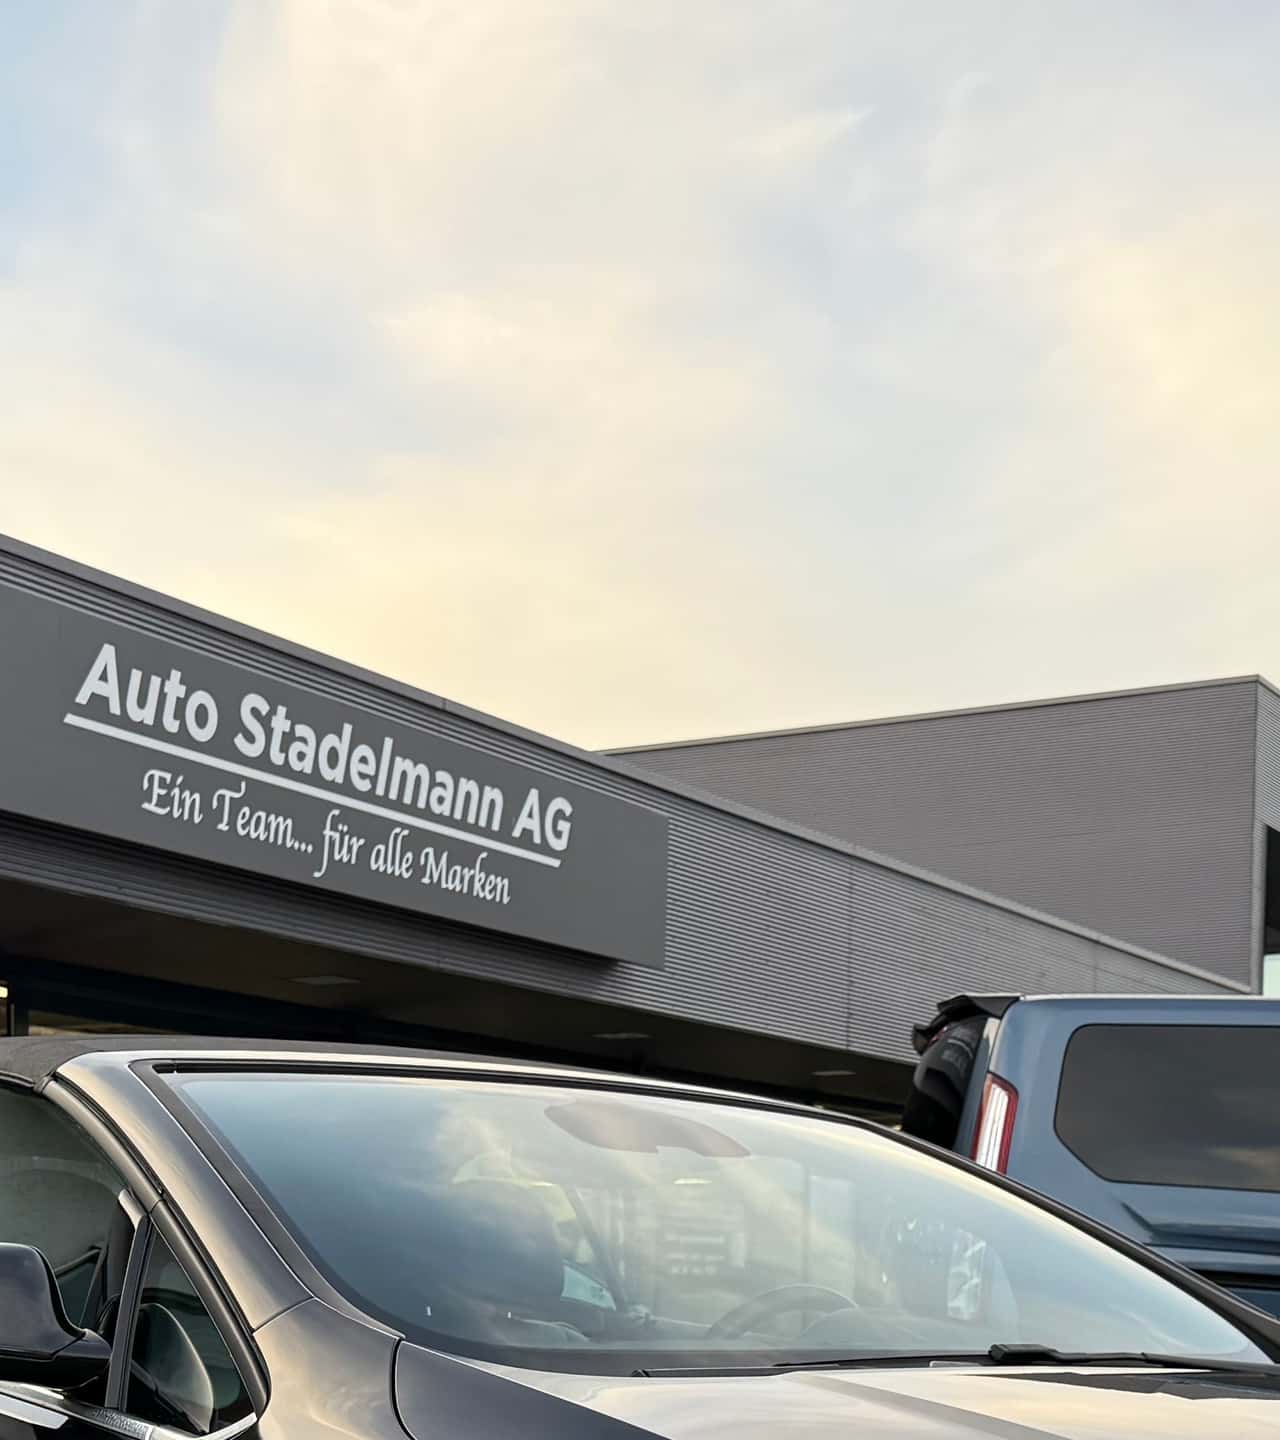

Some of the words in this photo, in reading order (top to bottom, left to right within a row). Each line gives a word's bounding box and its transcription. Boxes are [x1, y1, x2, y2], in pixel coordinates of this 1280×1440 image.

[75, 643, 218, 743] Auto
[234, 692, 503, 832] Stadelmann
[512, 788, 573, 852] AG
[141, 769, 203, 824] Ein
[212, 782, 314, 854] Team...
[314, 810, 364, 878] für
[370, 828, 413, 880] alle
[421, 847, 511, 905] Marken
